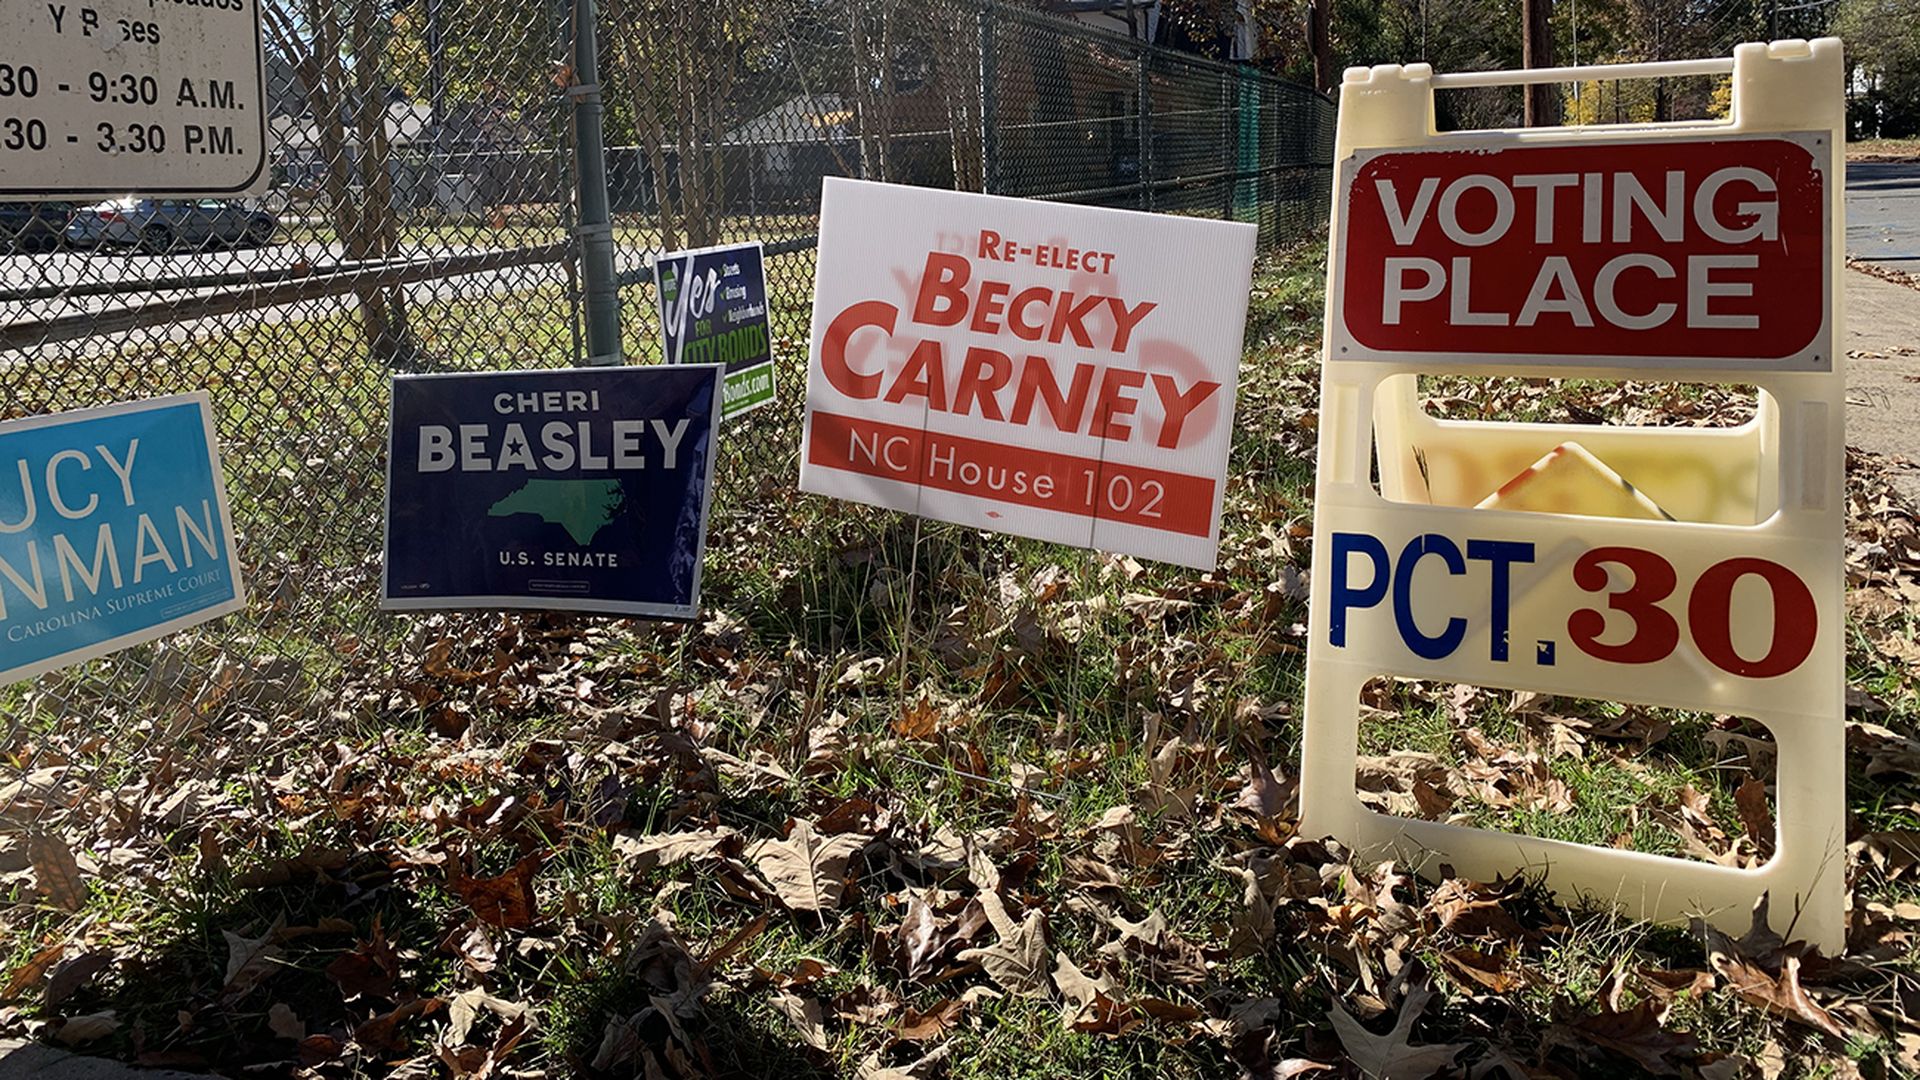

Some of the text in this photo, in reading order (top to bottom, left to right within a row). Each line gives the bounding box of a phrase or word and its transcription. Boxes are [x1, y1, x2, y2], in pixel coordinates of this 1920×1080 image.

[48, 4, 65, 34] Y
[89, 72, 157, 106] 9:30
[176, 78, 244, 110] A.M.
[184, 125, 243, 155] P.M.
[1374, 166, 1779, 247] VOTING
[977, 229, 1115, 275] RE-ELECT
[665, 255, 721, 364] Yes
[912, 251, 1157, 354] BECKY
[1381, 253, 1760, 330] PLACE
[717, 322, 768, 365] BONDS
[493, 390, 600, 414] CHERI
[820, 300, 1222, 450] CARNEY
[417, 418, 691, 473] BEASLEY
[848, 427, 1166, 519] NC House 102
[499, 551, 618, 568] U.S. SENATE
[7, 608, 102, 643] CAROLINA
[107, 584, 175, 615] SUPREME
[178, 568, 222, 592] COURT
